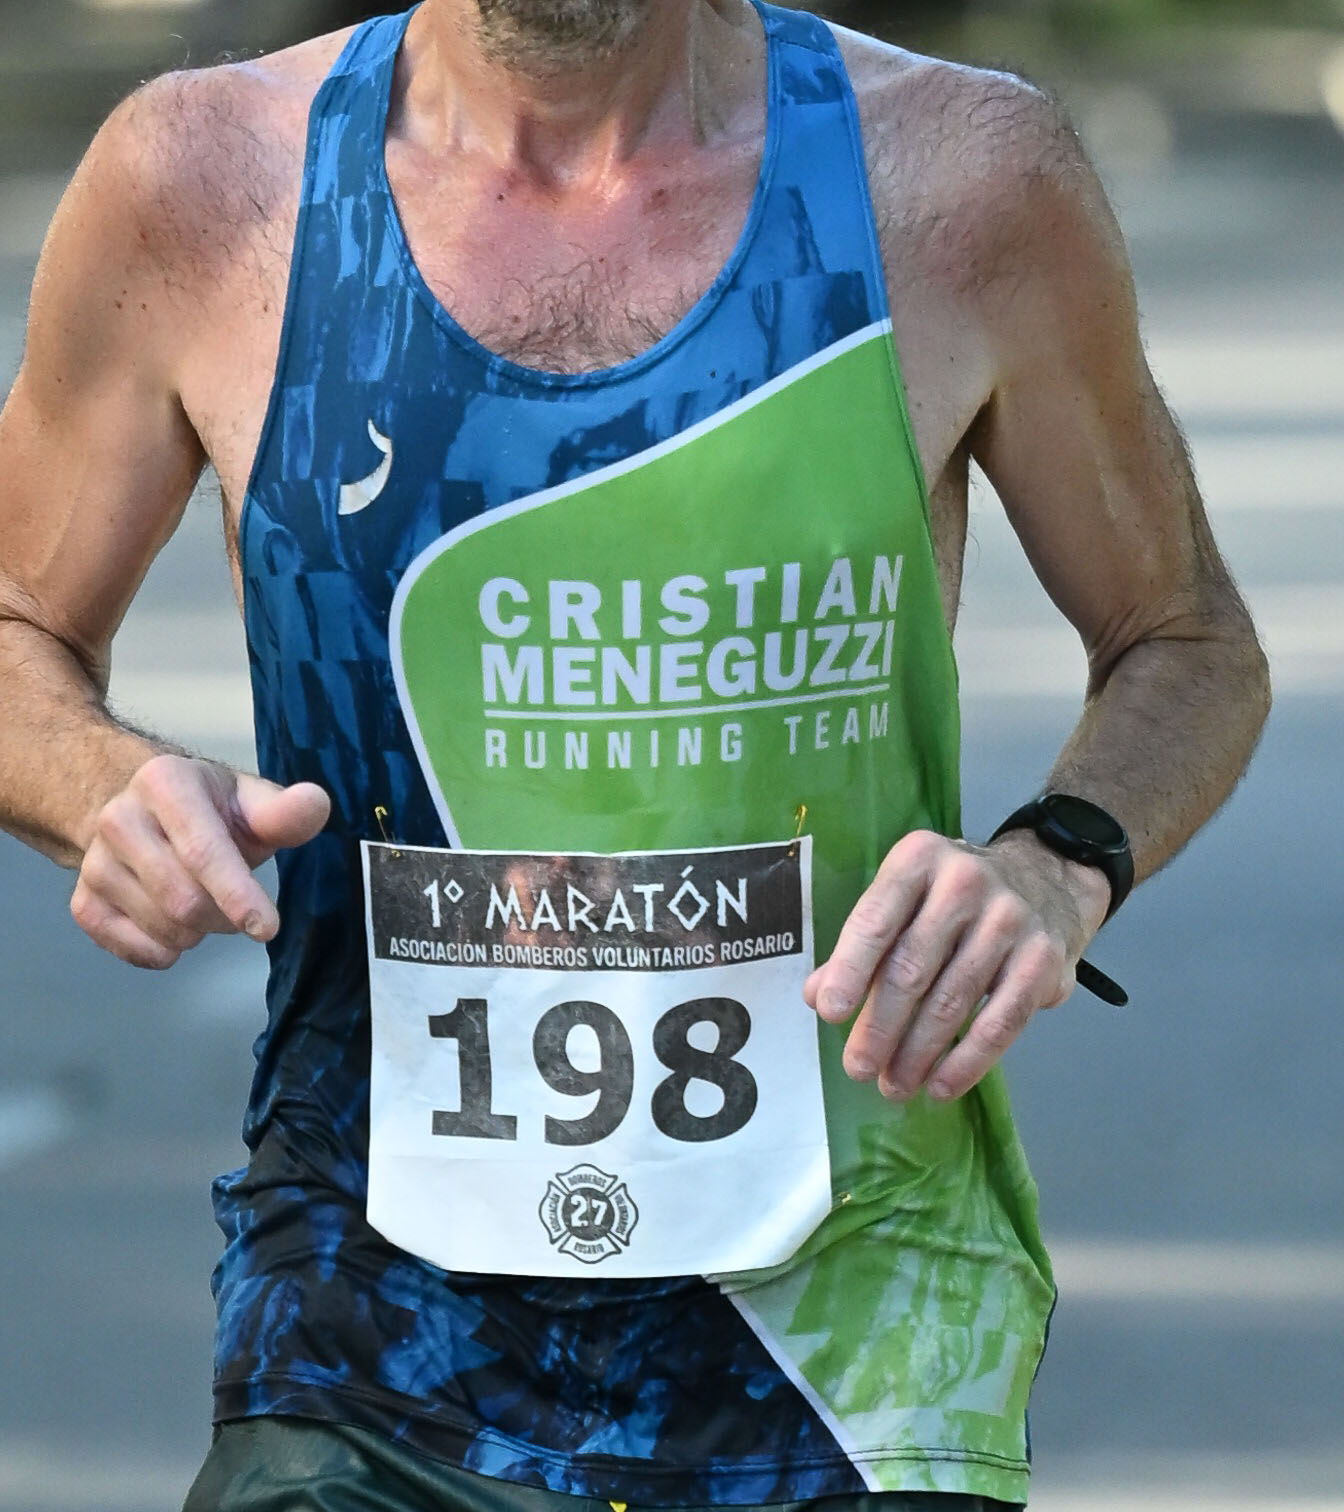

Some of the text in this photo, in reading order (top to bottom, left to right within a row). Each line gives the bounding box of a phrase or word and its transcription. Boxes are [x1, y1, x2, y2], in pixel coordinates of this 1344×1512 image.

[478, 554, 904, 639] CRISTIAN
[481, 619, 896, 705] MENEGUZZI
[485, 701, 890, 770] RUNNING TEAM
[485, 865, 748, 934] MARATÓN
[389, 931, 796, 968] ASOCIACIÓN BOMBEROS VOLUNTARIOS ROSARIO
[428, 998, 758, 1146] 198
[570, 1194, 608, 1227] 27
